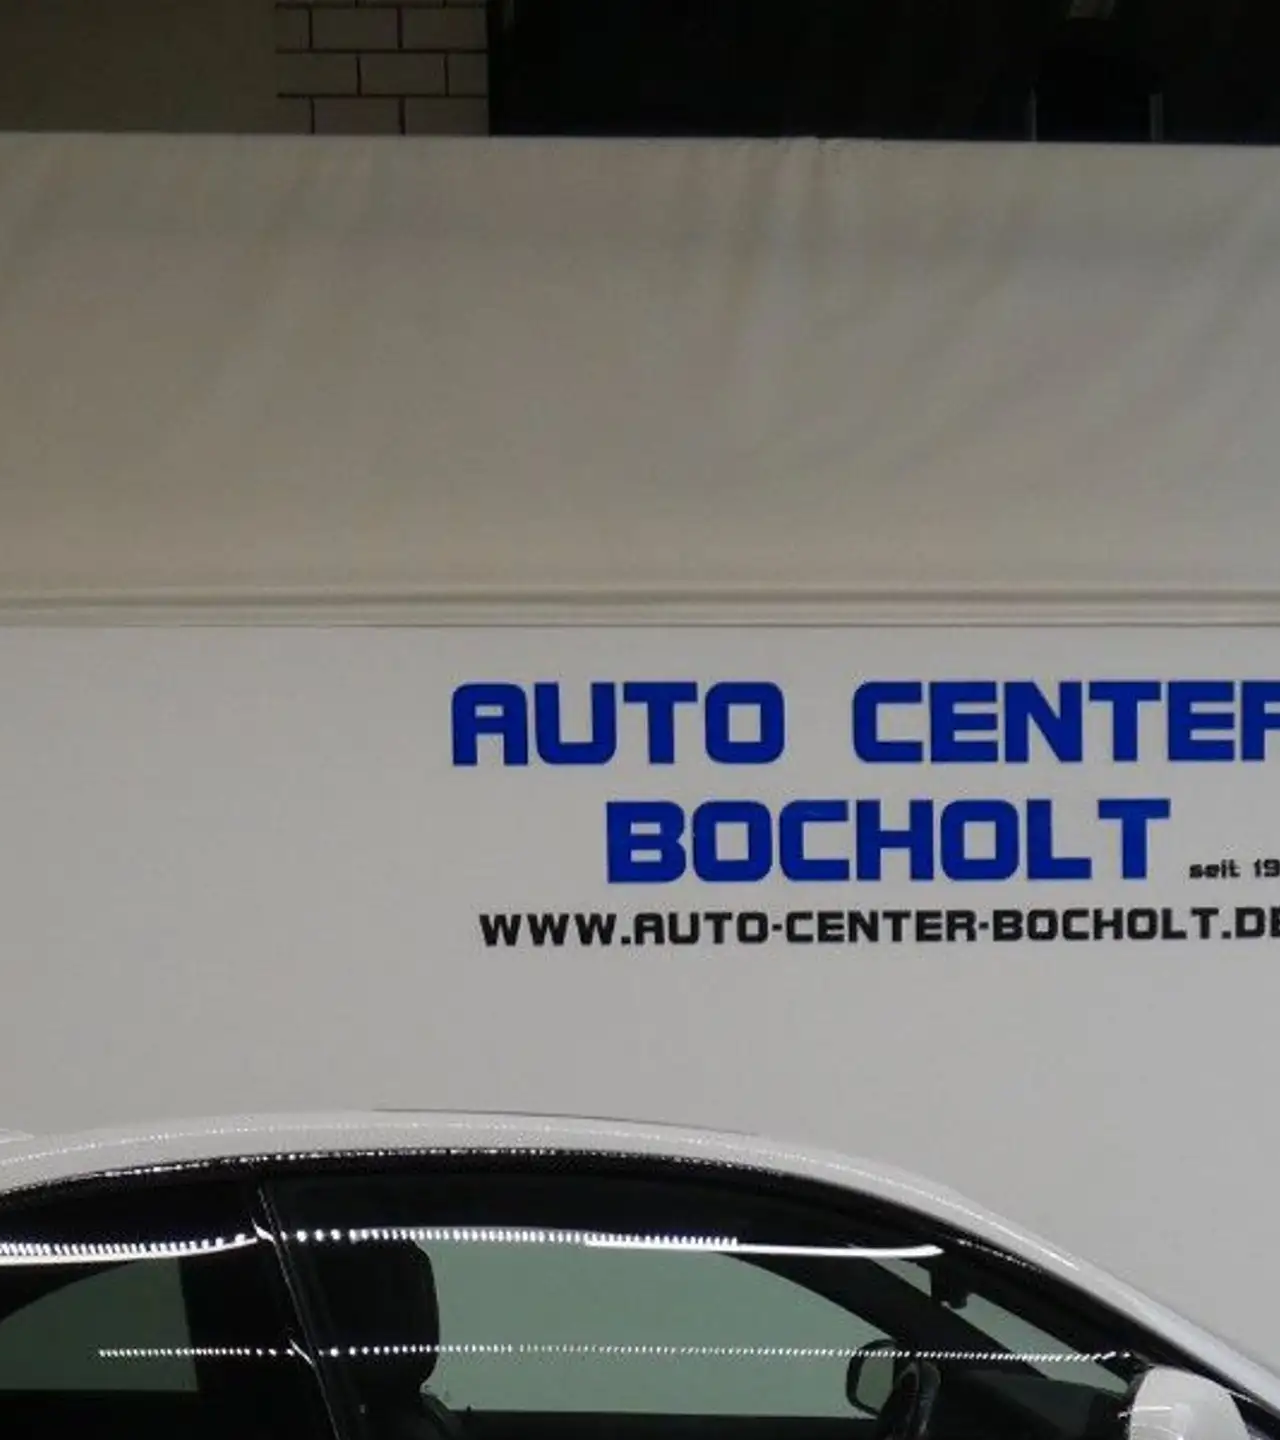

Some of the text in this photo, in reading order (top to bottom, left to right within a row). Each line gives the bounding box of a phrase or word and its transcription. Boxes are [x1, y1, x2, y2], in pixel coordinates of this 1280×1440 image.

[452, 681, 786, 767] AUTO
[606, 798, 1171, 885] BOCHOLT
[1189, 857, 1241, 879] seit
